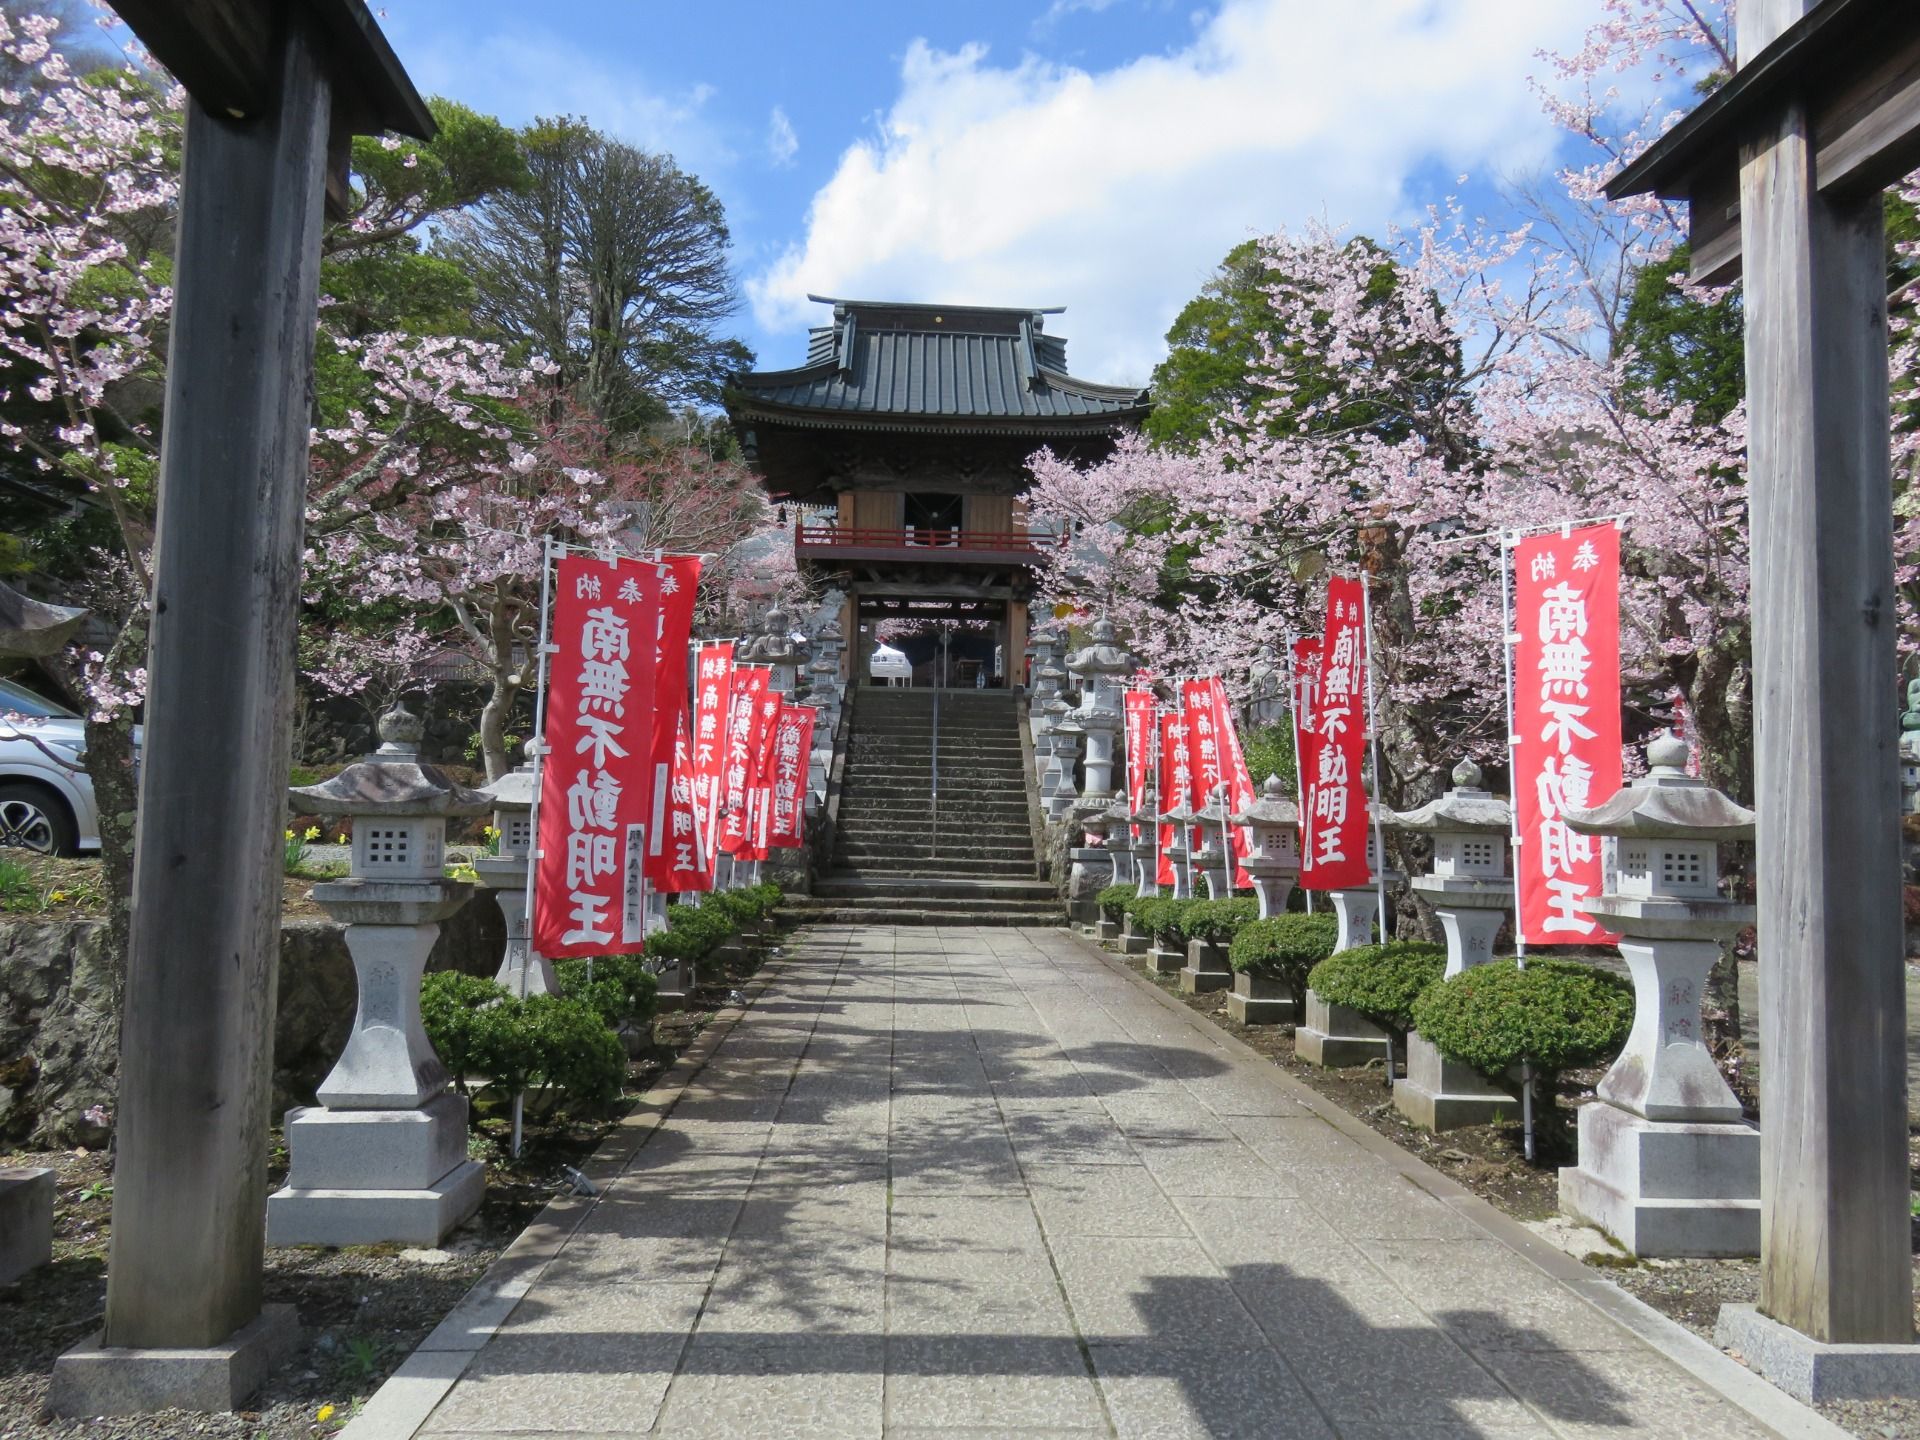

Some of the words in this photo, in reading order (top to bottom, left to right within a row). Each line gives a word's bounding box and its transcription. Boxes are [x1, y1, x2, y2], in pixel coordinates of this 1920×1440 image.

[1335, 598, 1357, 622] 奉納
[1315, 624, 1353, 866] 南無不動明王
